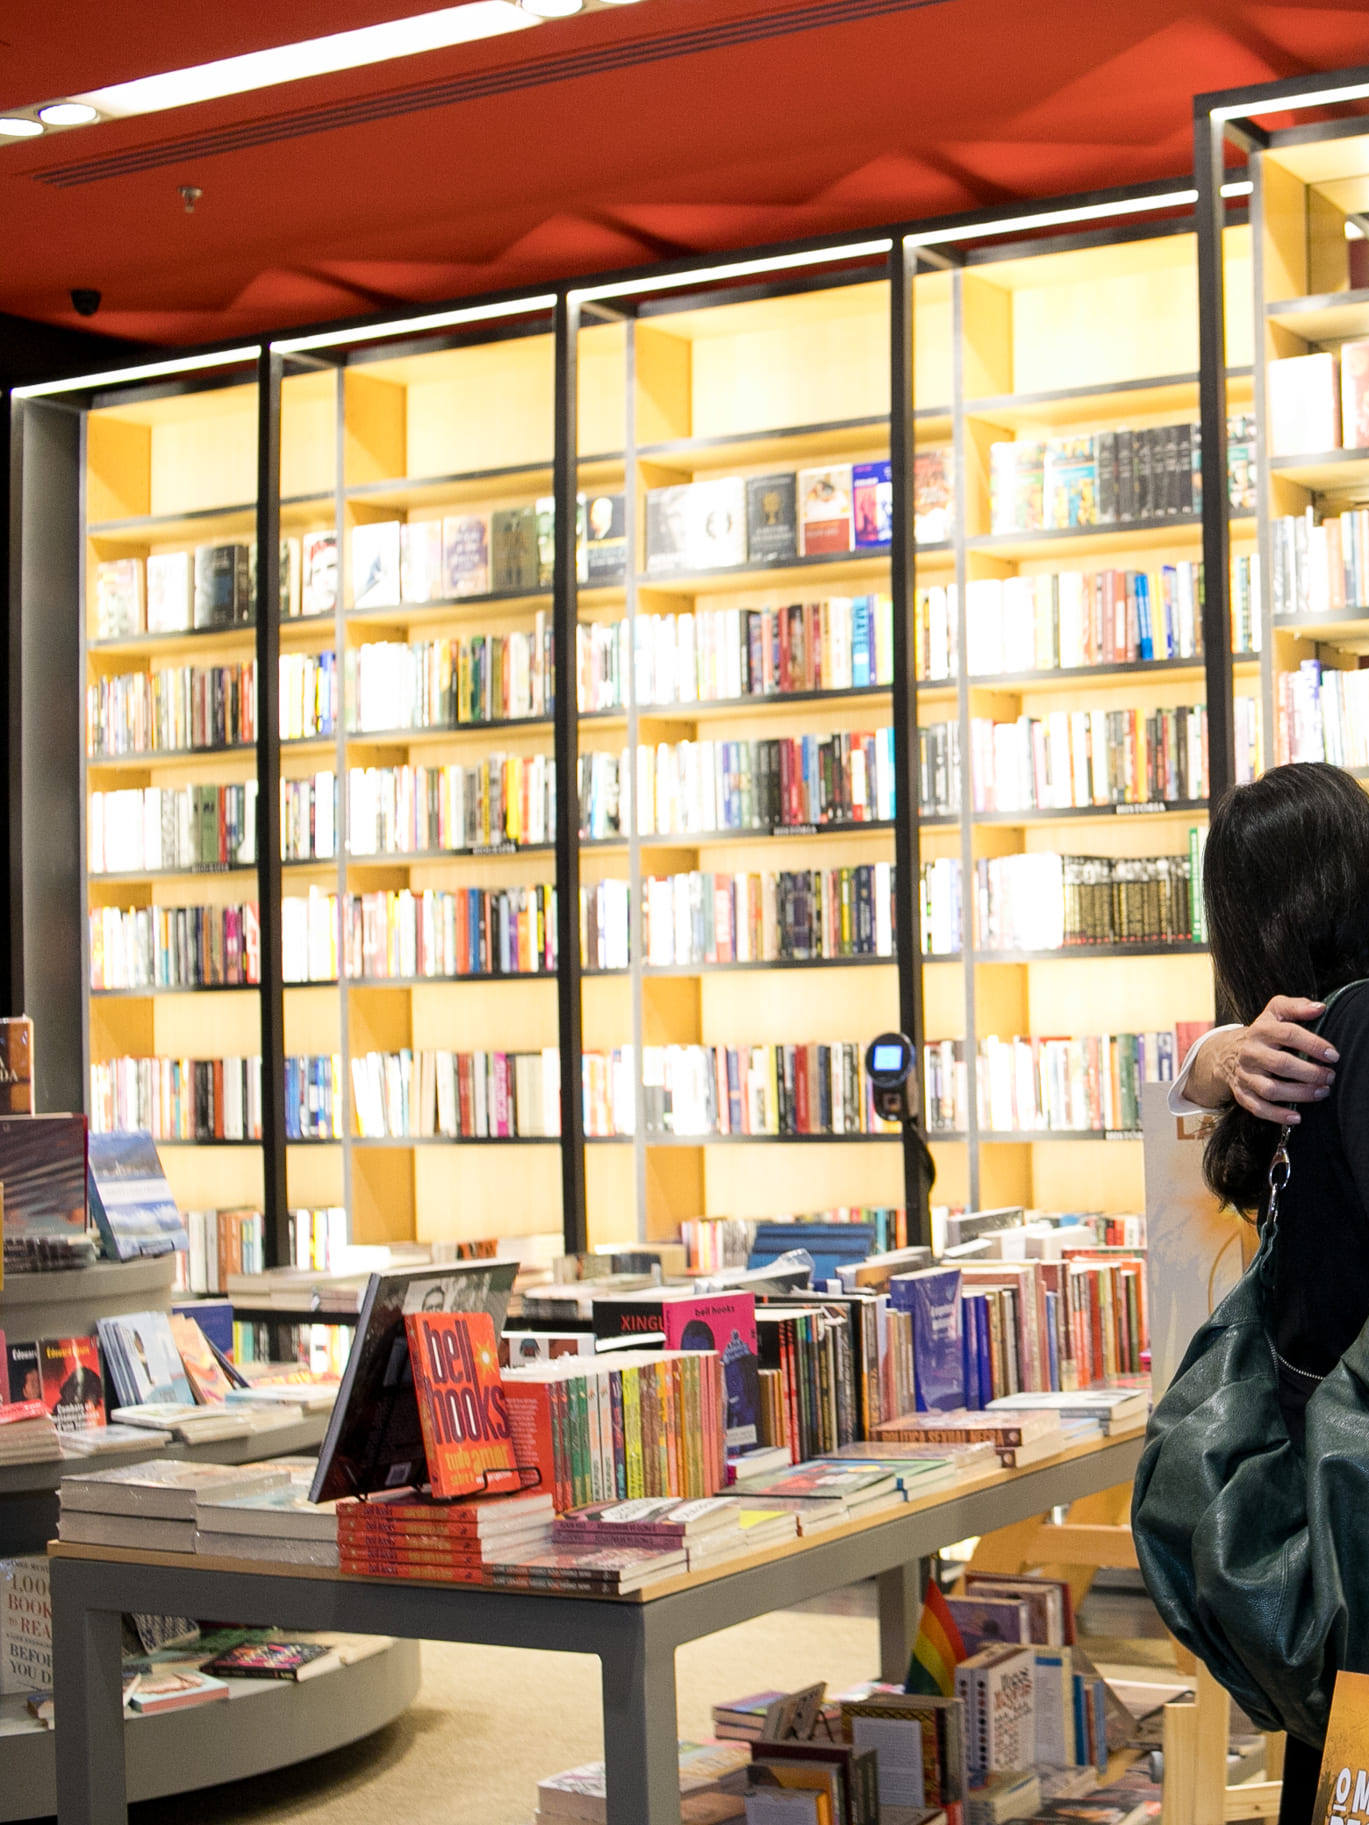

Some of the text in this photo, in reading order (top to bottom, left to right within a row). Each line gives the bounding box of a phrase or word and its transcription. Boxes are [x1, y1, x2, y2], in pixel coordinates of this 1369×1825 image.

[695, 1304, 735, 1317] bell hooks
[422, 1320, 474, 1384] bell
[424, 1376, 513, 1445] hooks
[444, 1446, 471, 1471] tudo
[12, 1573, 51, 1595] 1,00
[8, 1593, 52, 1619] BOOK
[20, 1616, 52, 1641] REA
[10, 1643, 52, 1667] BEFO
[9, 1660, 52, 1685] YOU D
[1335, 1767, 1352, 1805] O
